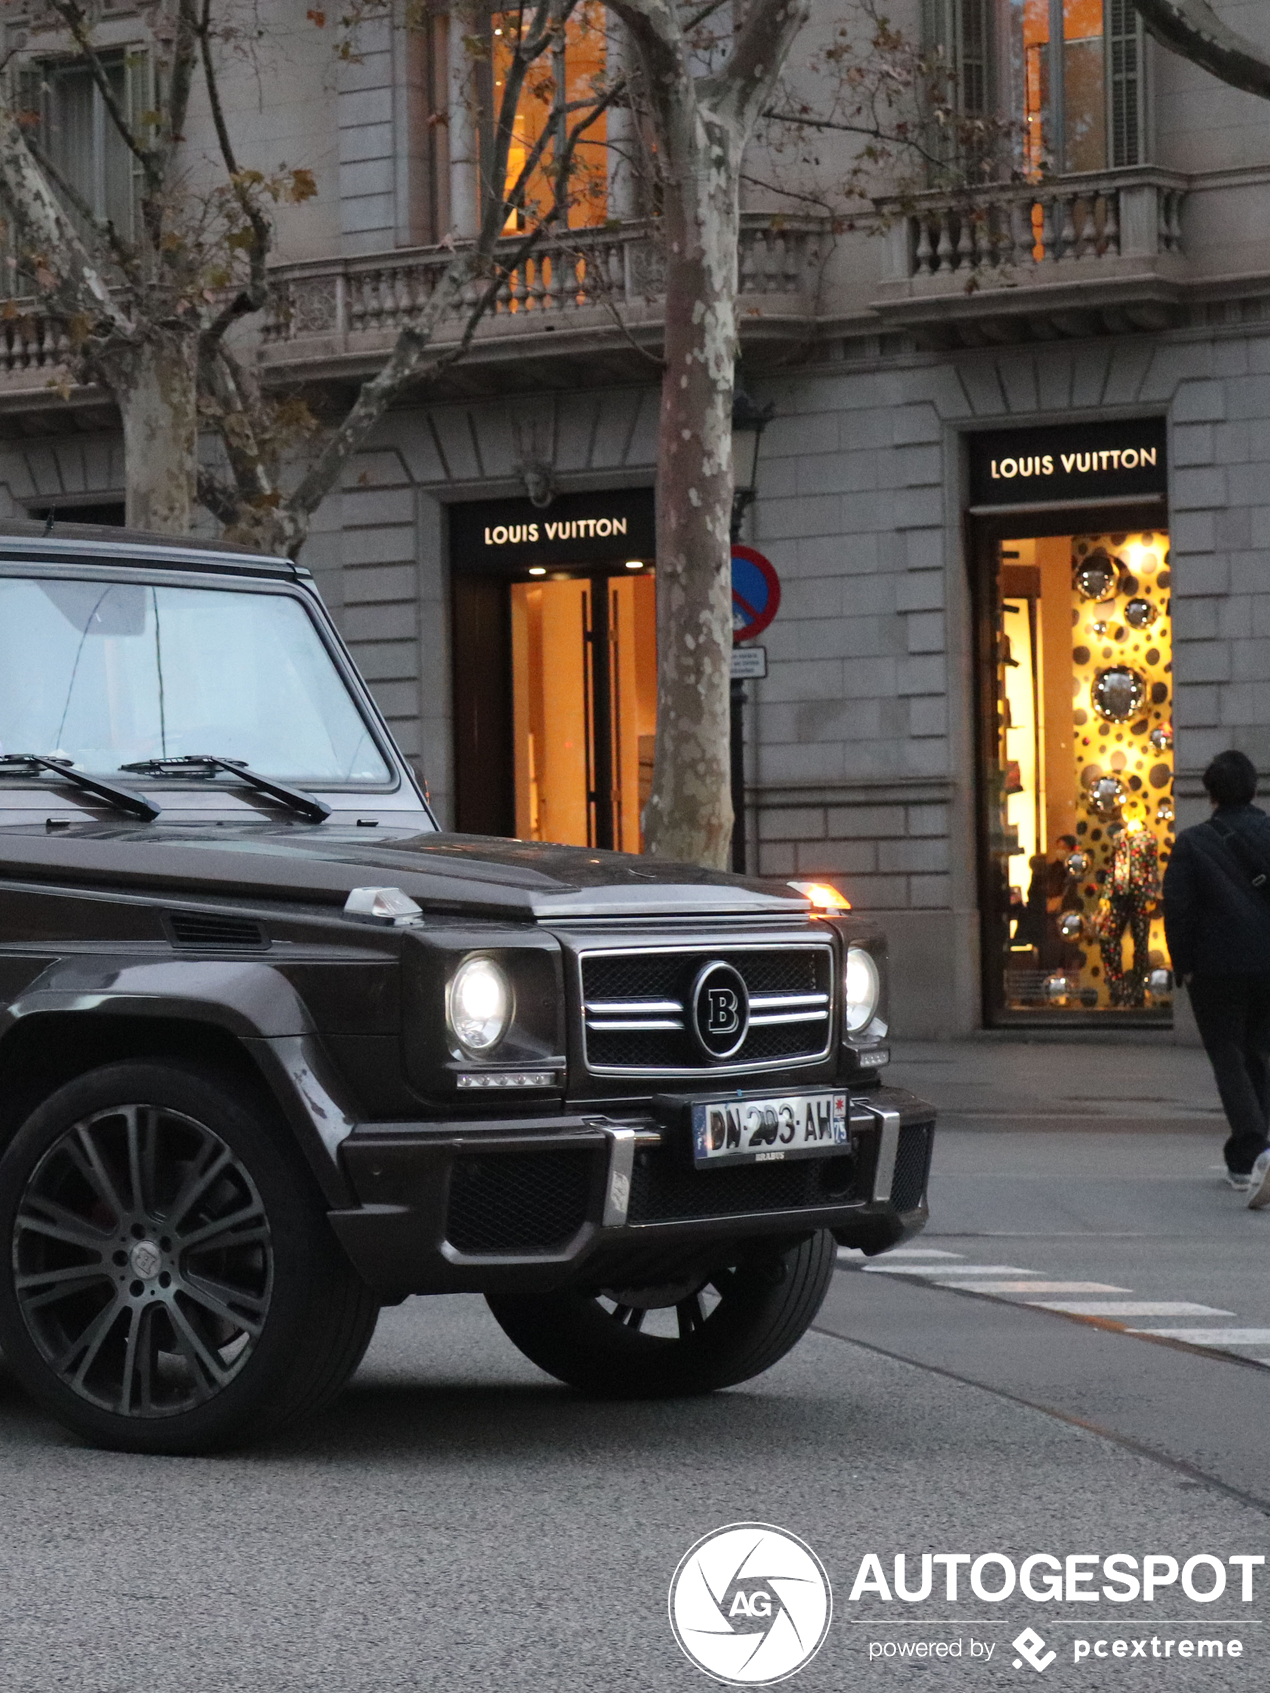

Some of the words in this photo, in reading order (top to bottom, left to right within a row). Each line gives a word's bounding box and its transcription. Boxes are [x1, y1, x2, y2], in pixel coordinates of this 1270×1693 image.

[991, 454, 1054, 479] LOUIS
[1060, 447, 1157, 473] VUITTON
[484, 523, 539, 545] LOUIS
[544, 517, 628, 540] VUITTON
[709, 988, 739, 1034] B
[755, 1151, 785, 1162] BRABUS
